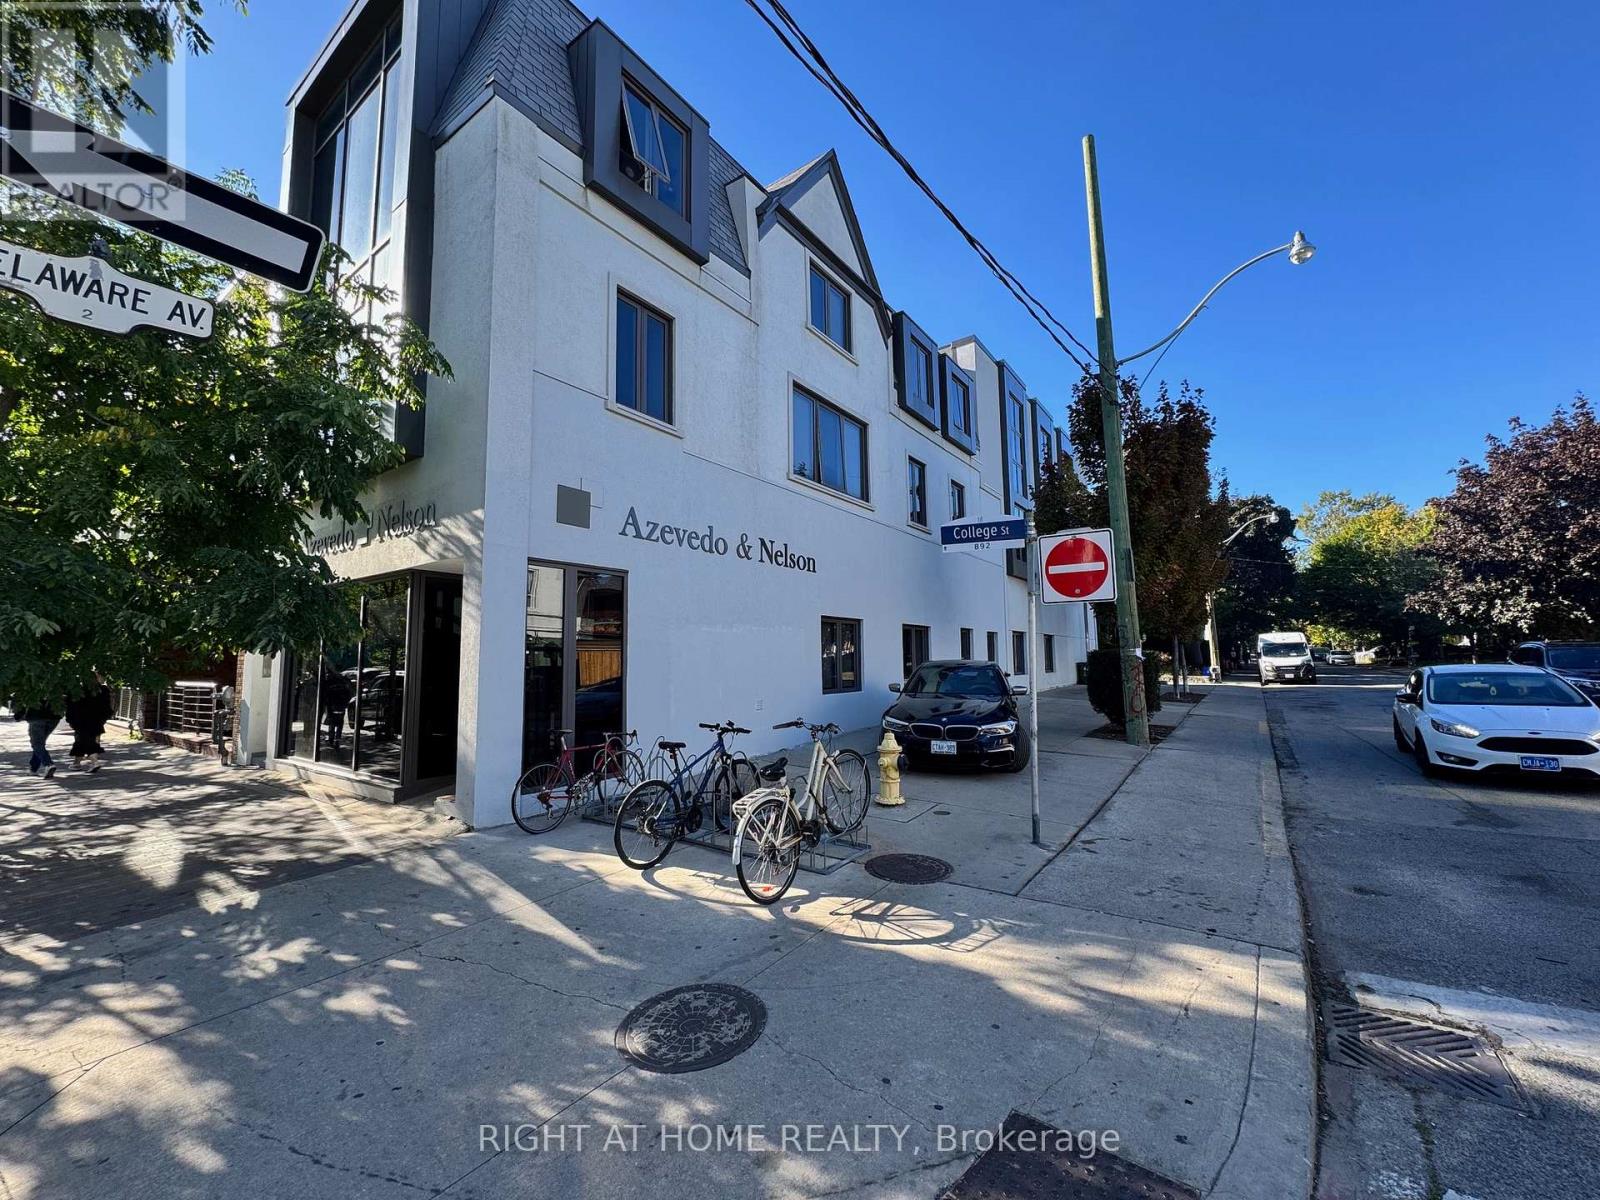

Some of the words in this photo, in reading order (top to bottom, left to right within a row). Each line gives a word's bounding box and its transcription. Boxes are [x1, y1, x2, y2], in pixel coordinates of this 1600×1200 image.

[82, 309, 93, 320] 2
[378, 500, 436, 543] Nelson
[953, 526, 998, 539] College
[1000, 525, 1009, 536] St
[618, 506, 729, 556] Azevedo
[736, 532, 752, 560] &
[758, 537, 816, 573] Nelson
